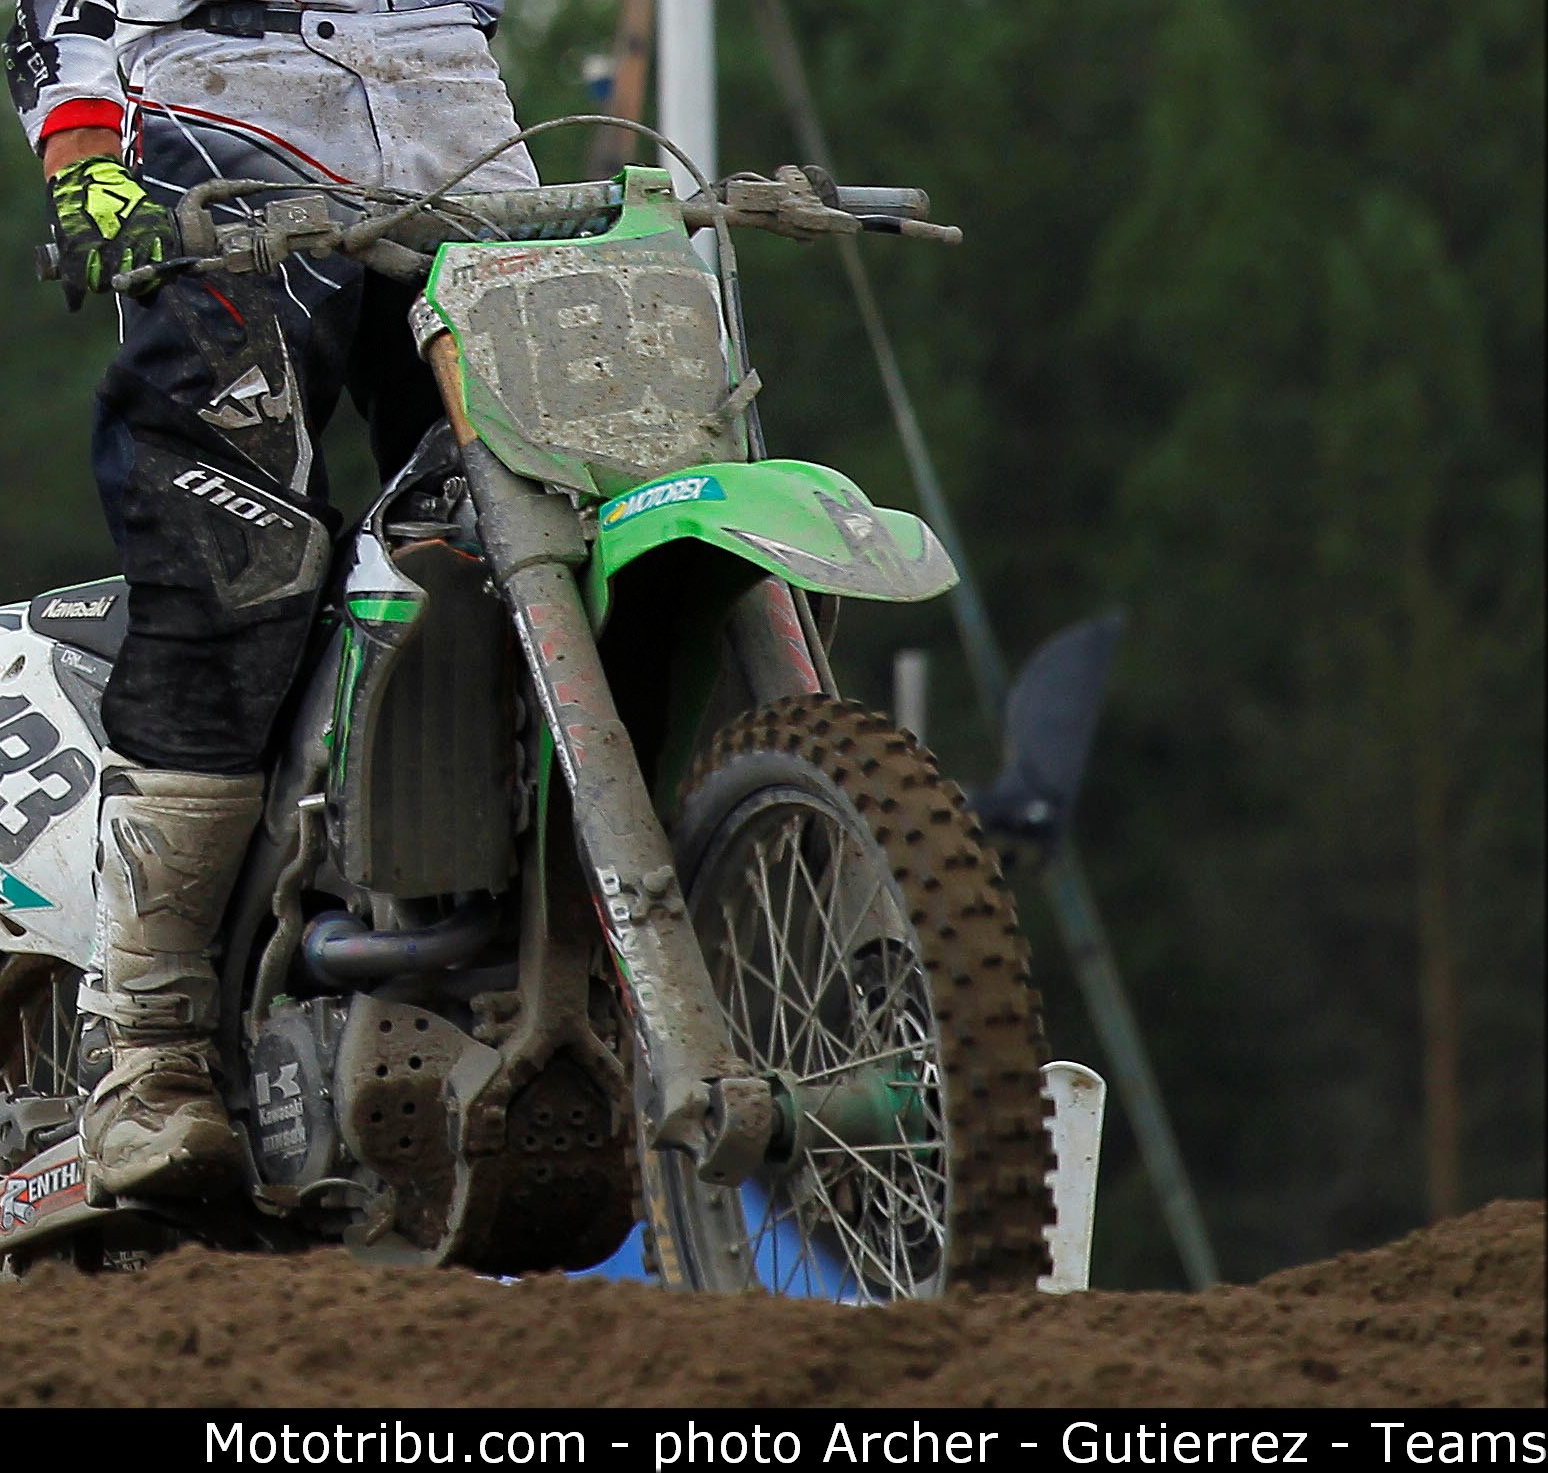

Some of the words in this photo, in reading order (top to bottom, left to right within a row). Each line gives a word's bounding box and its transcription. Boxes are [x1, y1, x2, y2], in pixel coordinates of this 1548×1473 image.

[172, 469, 295, 529] thor
[620, 477, 710, 520] MOTOREX
[40, 594, 117, 620] Kawasaki
